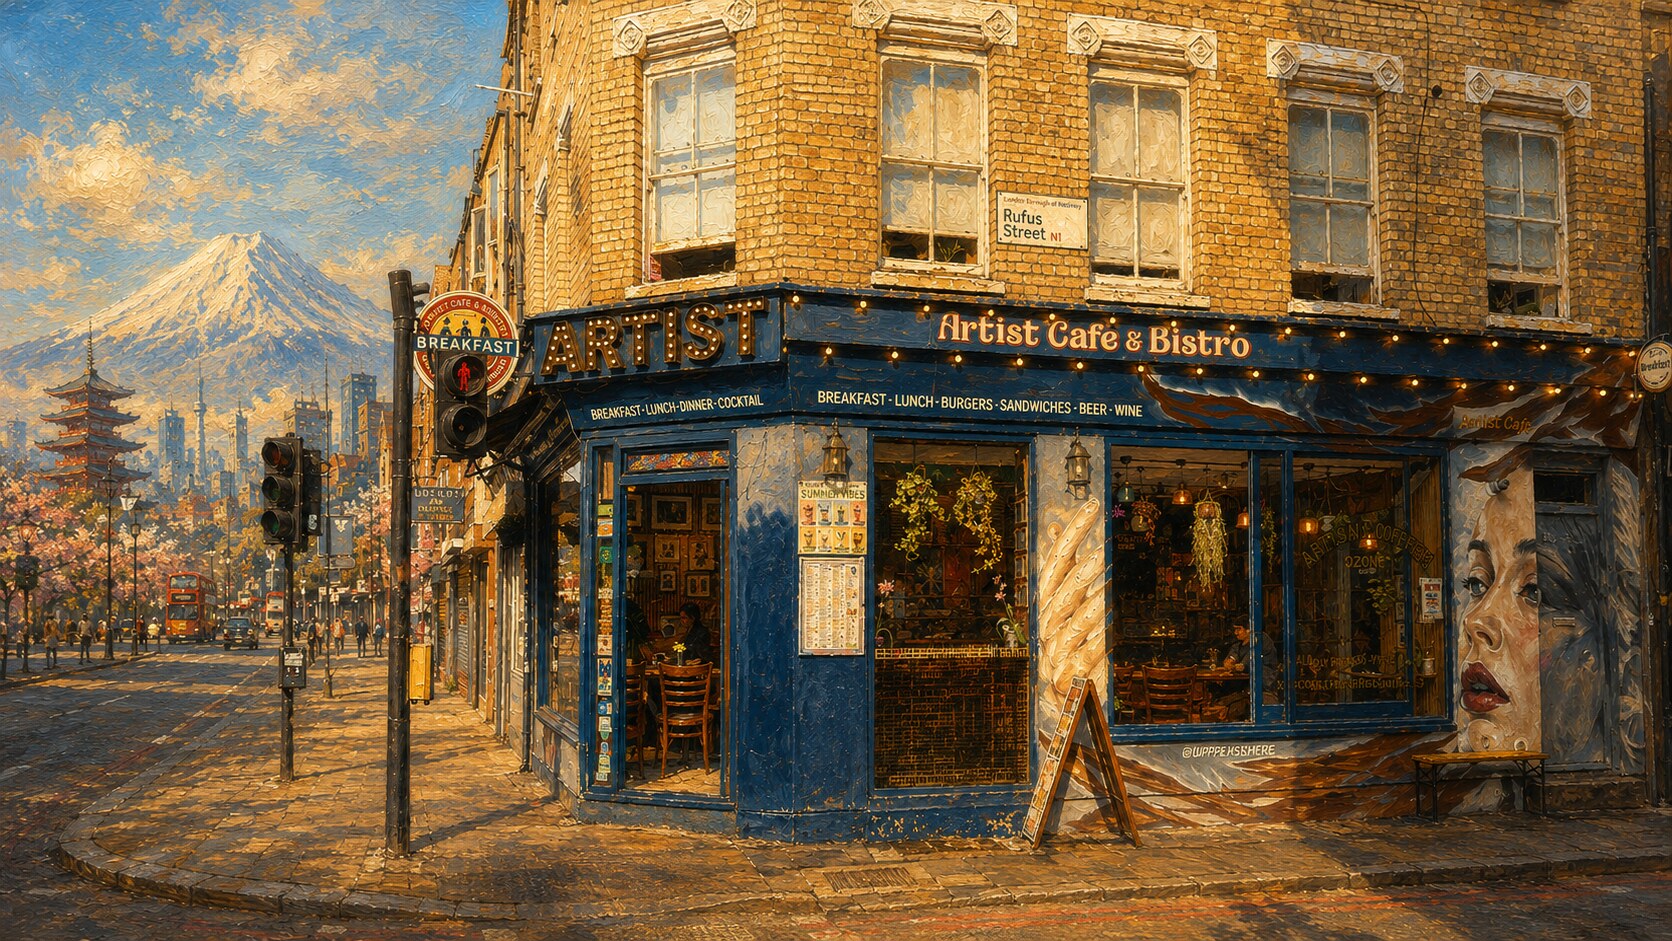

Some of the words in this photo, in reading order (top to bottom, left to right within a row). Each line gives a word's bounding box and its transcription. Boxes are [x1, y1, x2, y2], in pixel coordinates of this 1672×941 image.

[1003, 208, 1043, 225] Rufus
[1003, 223, 1047, 241] Street
[416, 335, 514, 354] BREAKFAST
[540, 295, 770, 377] ARTIST
[937, 311, 1040, 347] Artist
[1124, 329, 1143, 353] &
[1148, 325, 1252, 359] Bistro
[590, 404, 641, 421] BREAKFAST
[645, 401, 677, 416] LUNCH
[679, 398, 714, 413] DINNER
[717, 394, 764, 410] COCKTAIL
[817, 390, 887, 406] BREAKFAST
[895, 394, 934, 408] LUNCH
[941, 396, 993, 411] BURGERS
[999, 398, 1071, 415] SANDWICHES
[1079, 402, 1108, 416] BEER
[1114, 404, 1143, 418] WINE
[1344, 555, 1385, 569] OZONE
